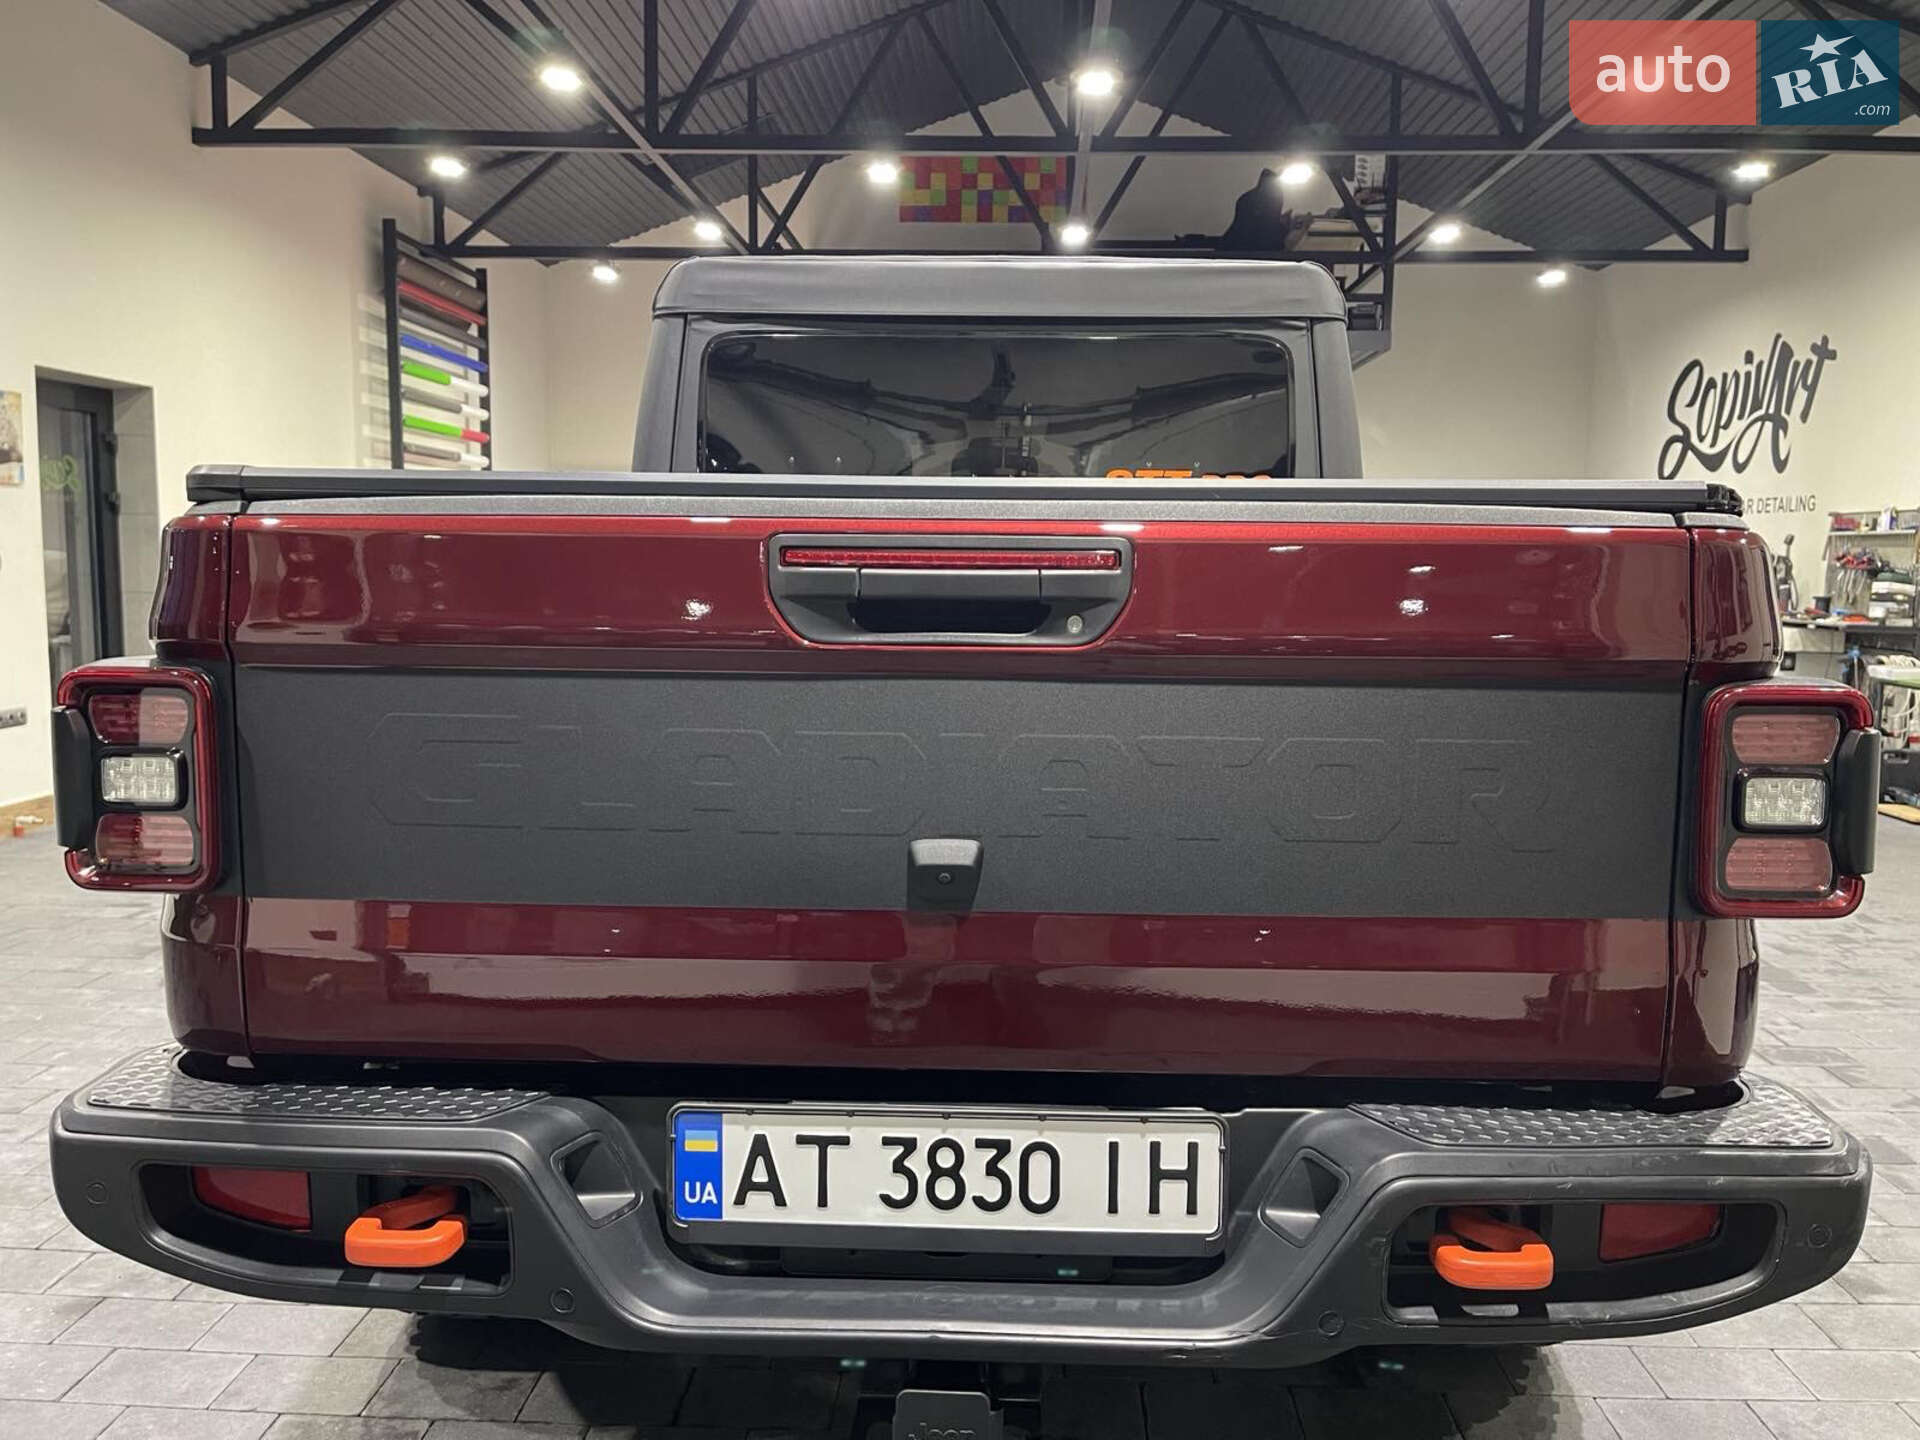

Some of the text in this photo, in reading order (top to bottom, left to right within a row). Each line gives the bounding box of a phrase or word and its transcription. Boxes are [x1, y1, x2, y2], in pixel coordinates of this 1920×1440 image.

[1756, 494, 1817, 514] DETAILING
[367, 712, 1558, 853] GLADIATOR
[684, 1181, 719, 1205] UA
[733, 1133, 1199, 1216] AT 3830 IH
